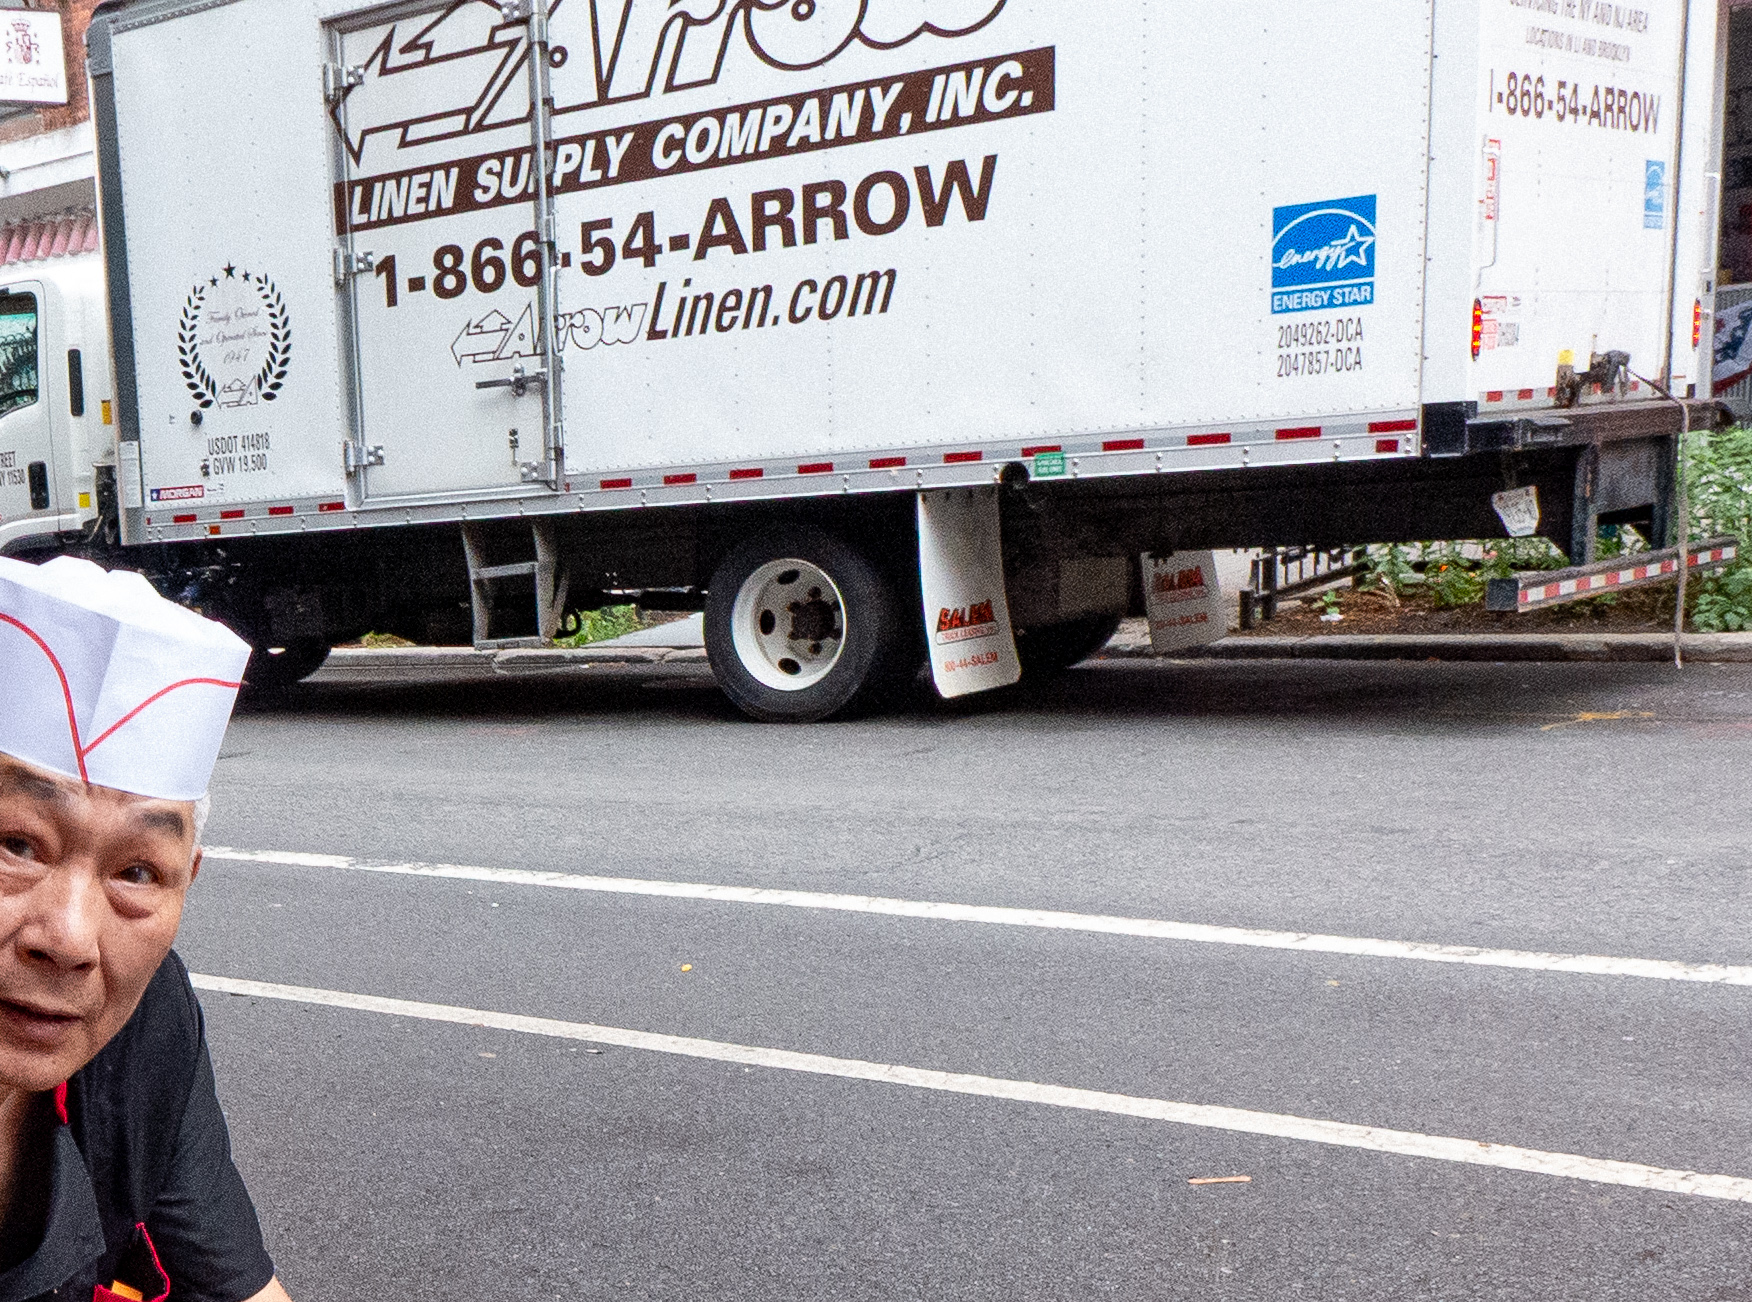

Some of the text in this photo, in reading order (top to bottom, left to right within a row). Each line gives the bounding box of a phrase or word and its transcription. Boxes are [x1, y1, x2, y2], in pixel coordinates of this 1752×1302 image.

[1489, 68, 1660, 135] 1-866-54-ARROW
[351, 59, 1034, 226] LINEN SUPLY COMPANY, INC.
[375, 153, 998, 308] 1-866-54-ARROW
[1273, 285, 1372, 312] ENERGY STAR
[1277, 317, 1364, 349] 2049262-DCA
[1276, 346, 1363, 378] 2047857-DCA
[208, 435, 238, 456] USDOT
[213, 455, 236, 476] GVW
[159, 486, 204, 500] MORGAN
[937, 597, 995, 633] SALEM
